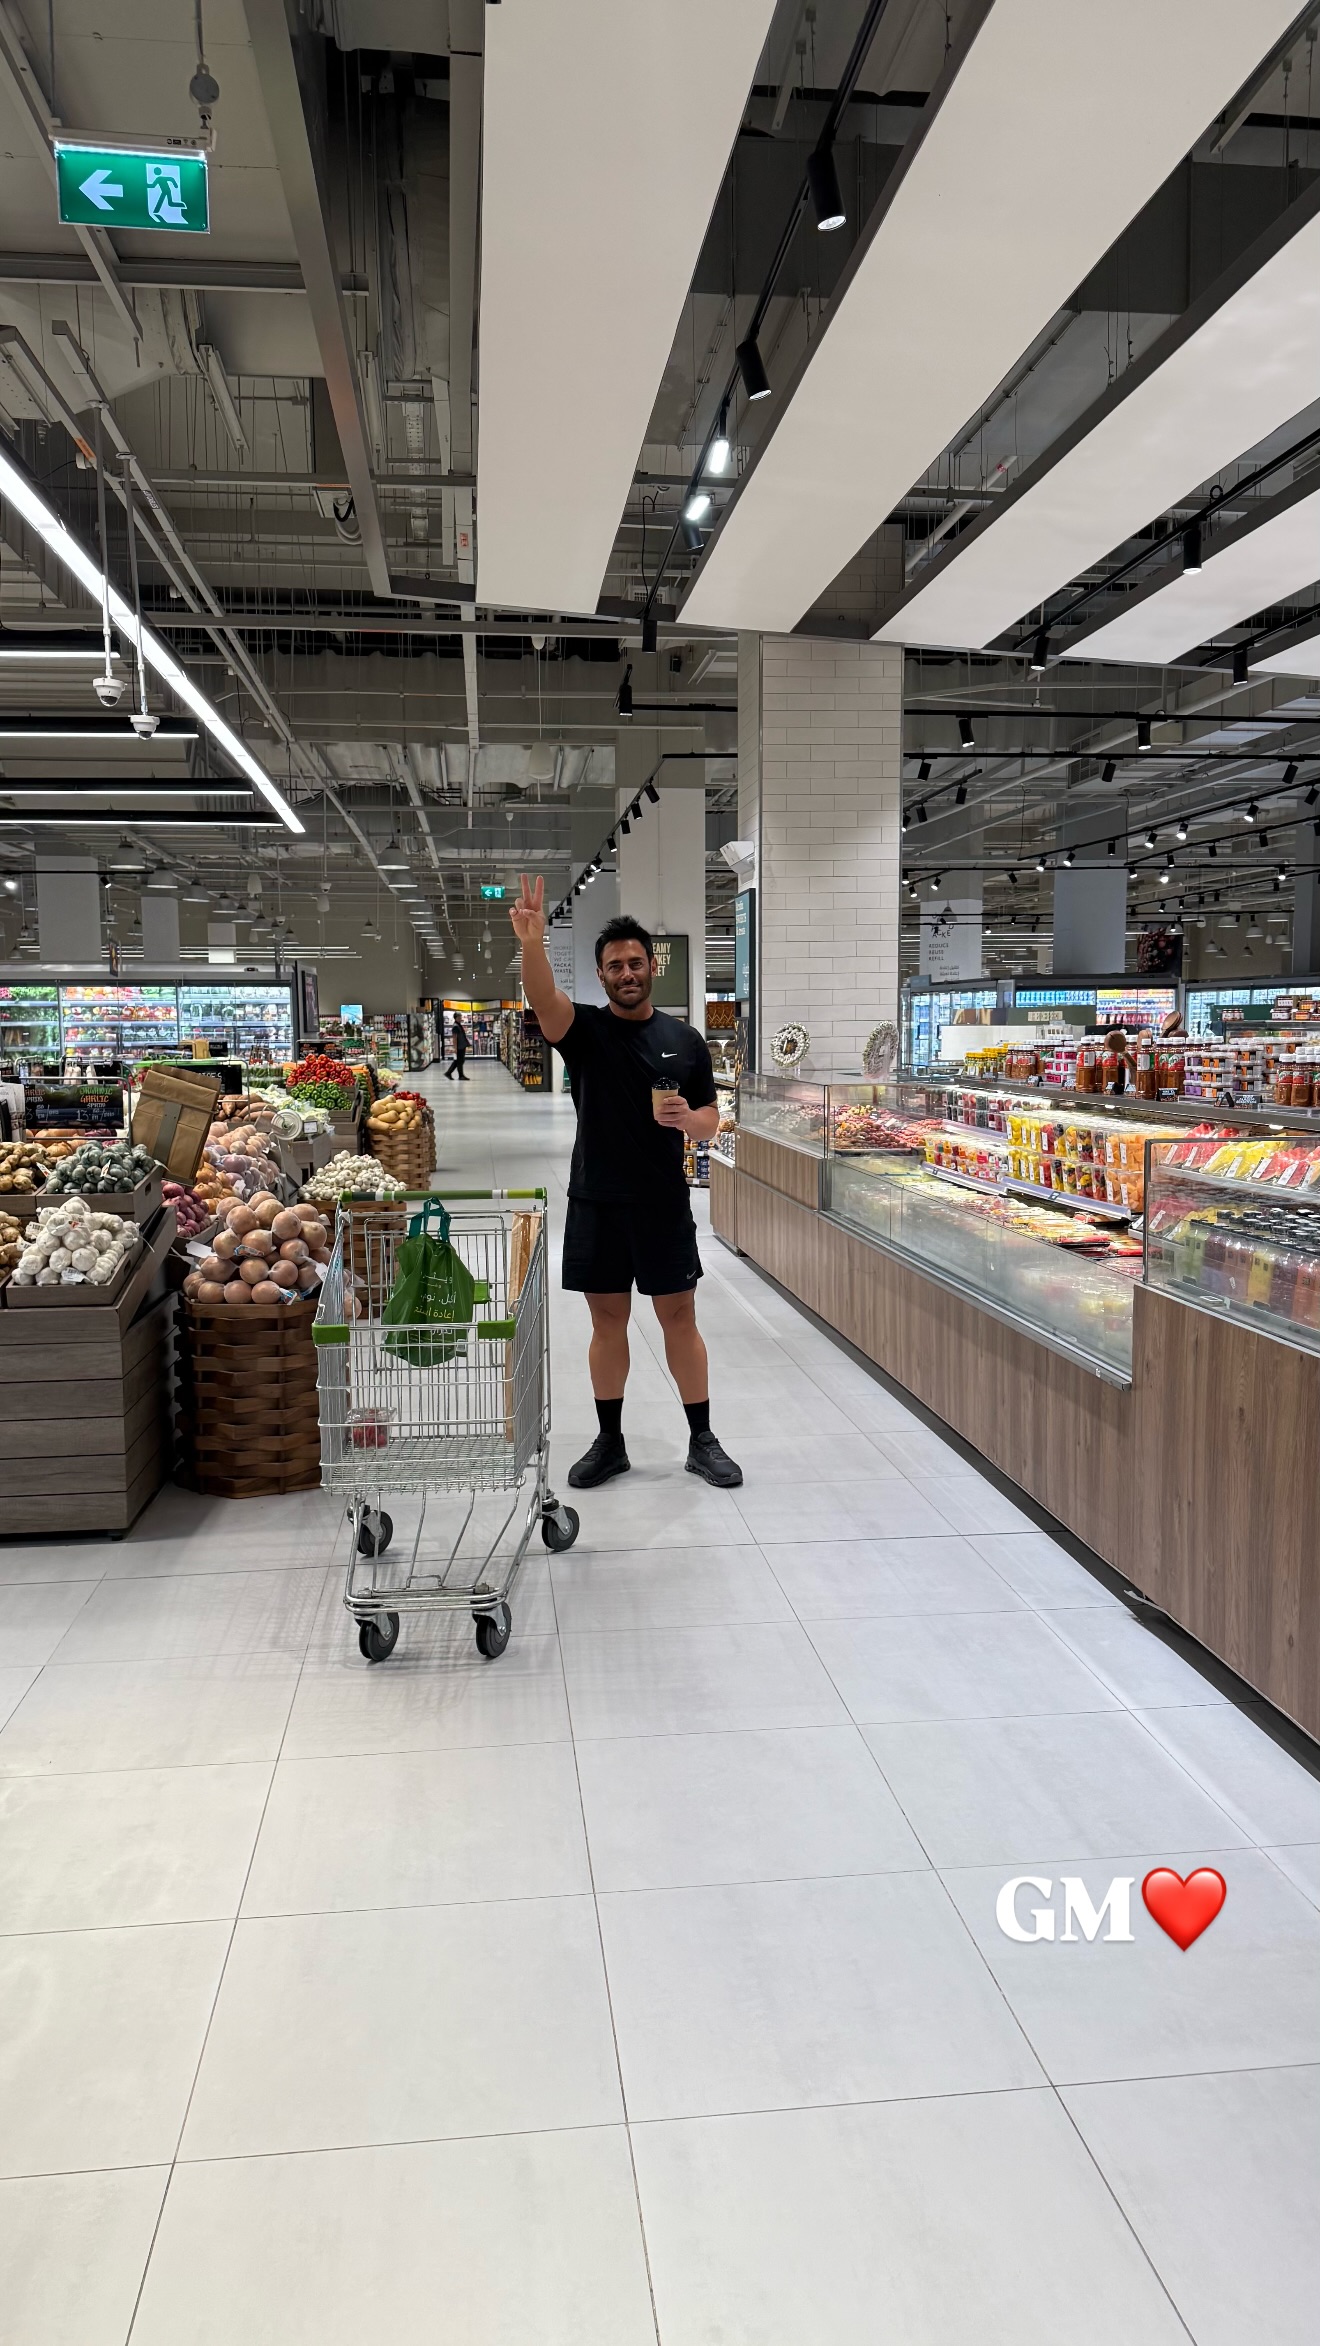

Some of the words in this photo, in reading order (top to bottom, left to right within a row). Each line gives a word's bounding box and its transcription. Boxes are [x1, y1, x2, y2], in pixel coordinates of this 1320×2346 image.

[652, 943, 671, 953] EAMY
[656, 966, 666, 977] ET
[80, 1095, 109, 1103] GARLIC
